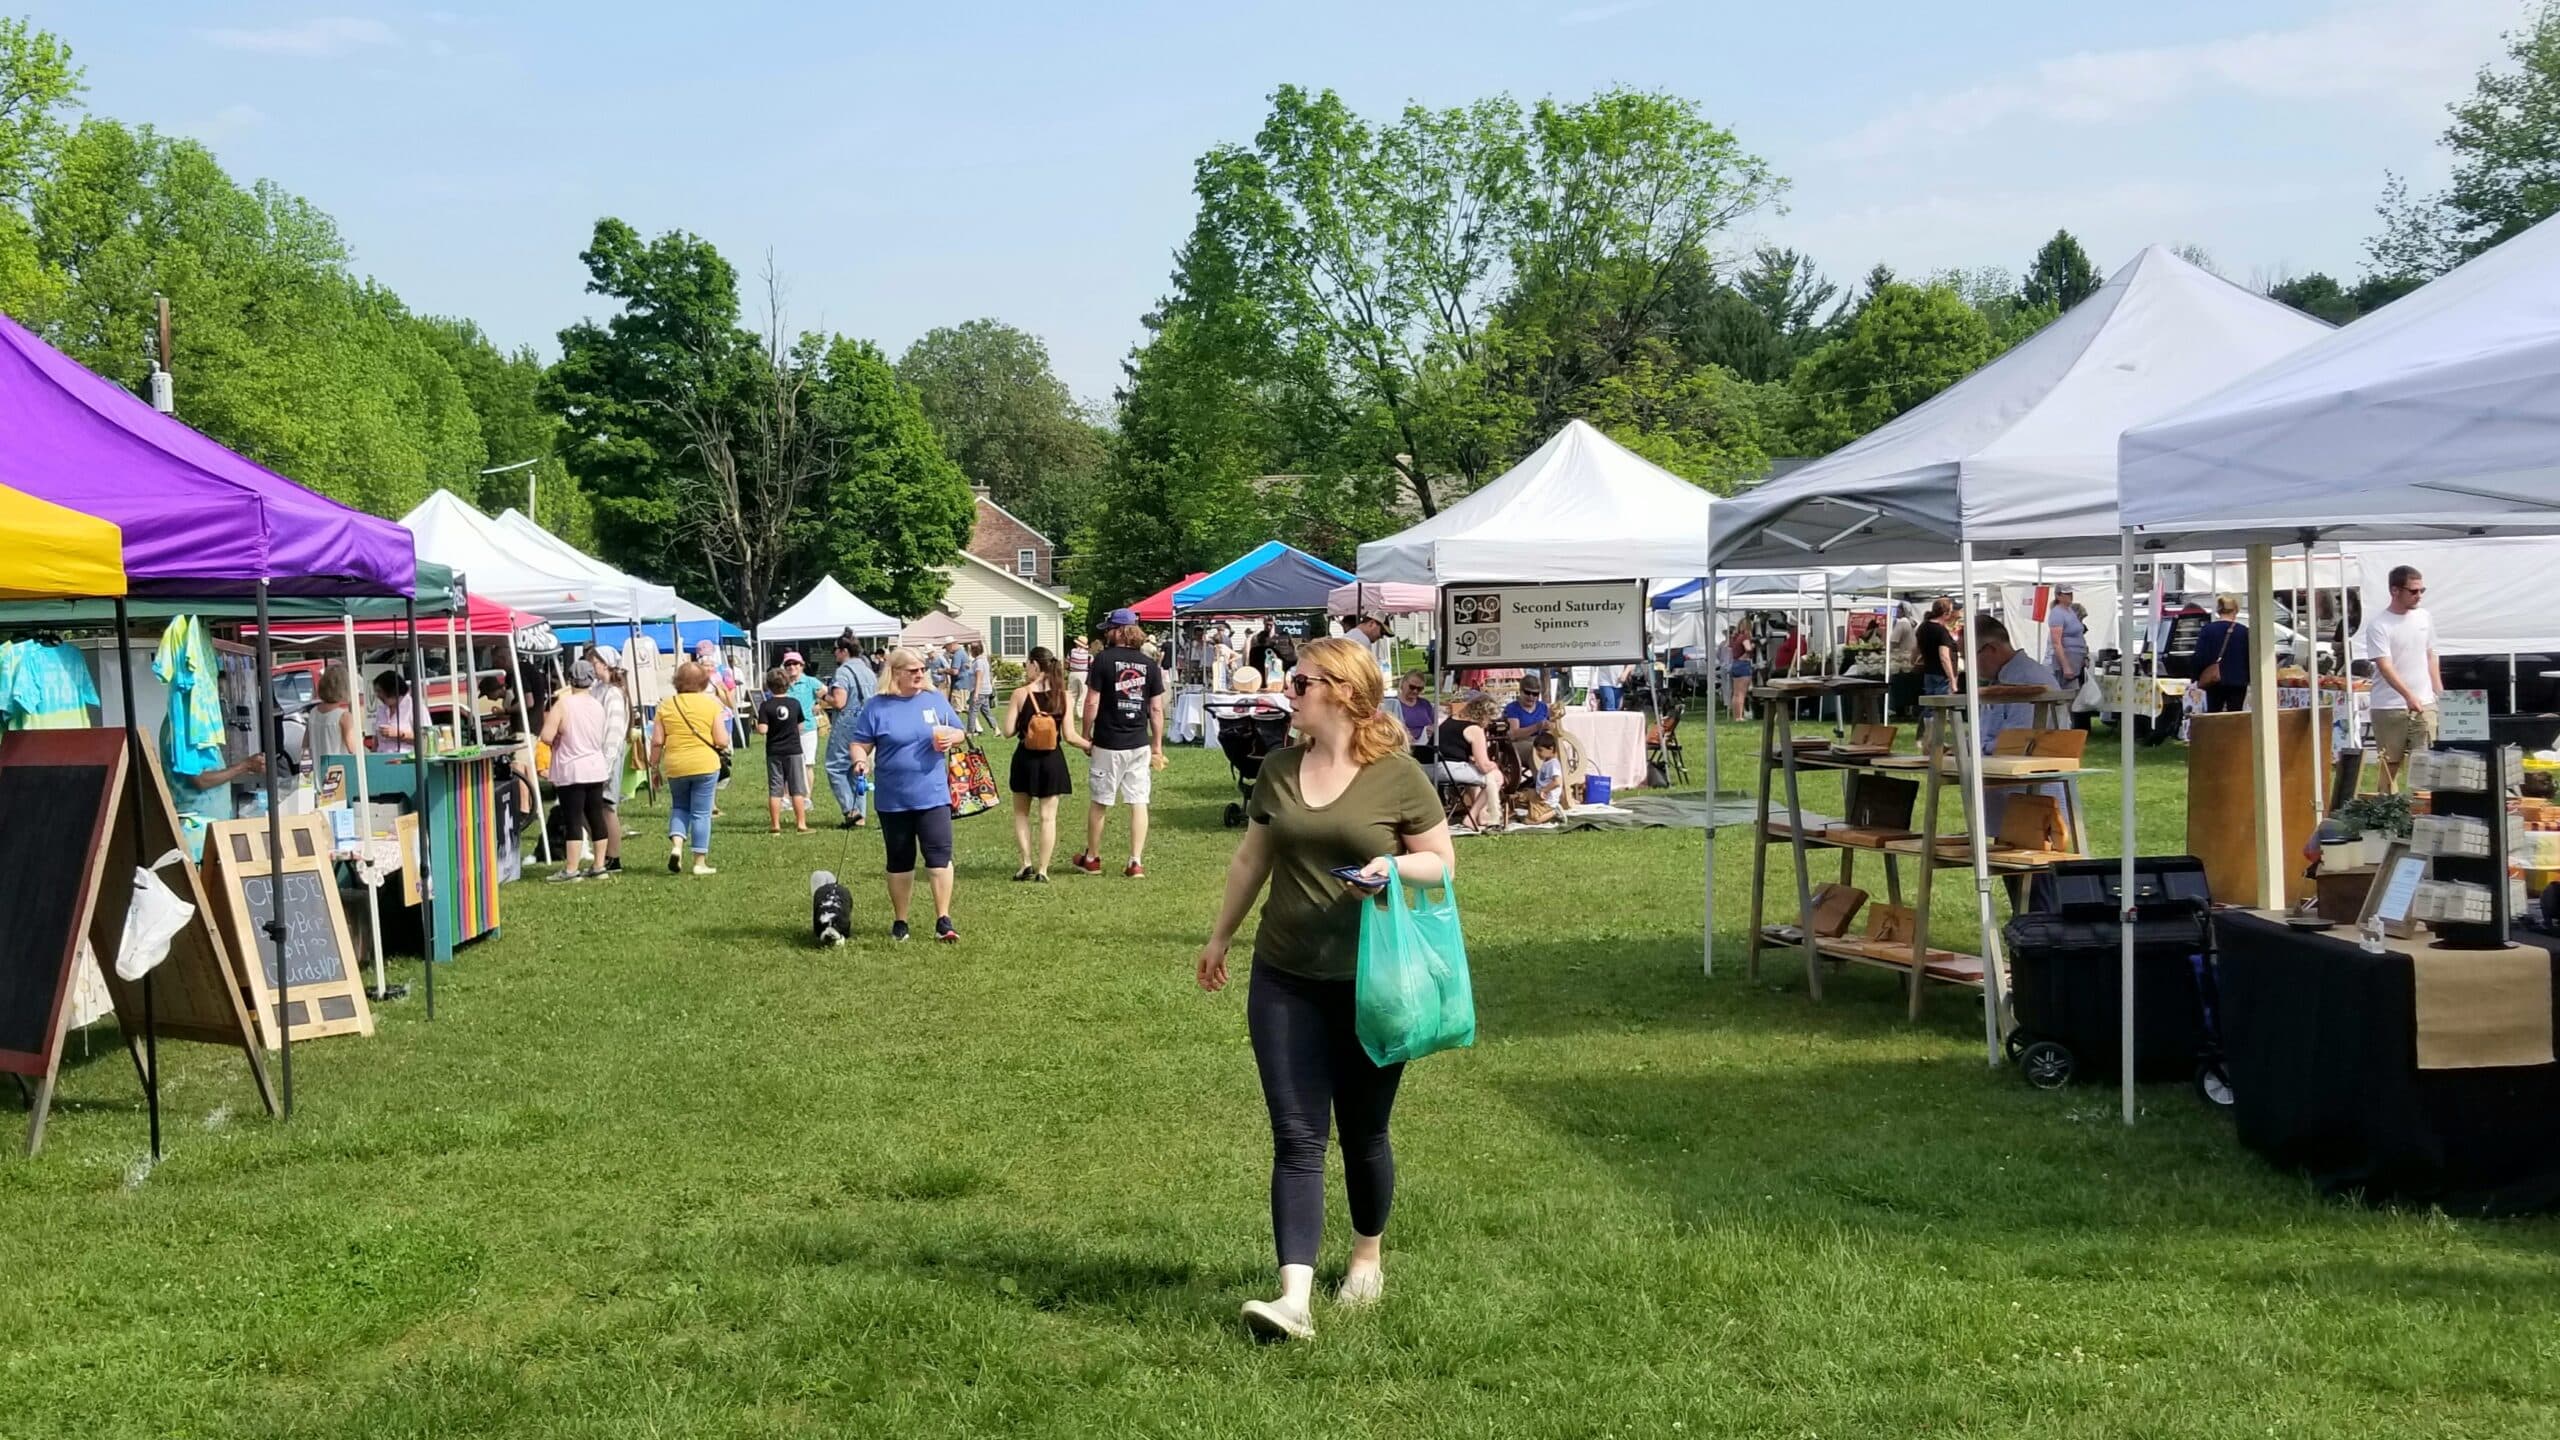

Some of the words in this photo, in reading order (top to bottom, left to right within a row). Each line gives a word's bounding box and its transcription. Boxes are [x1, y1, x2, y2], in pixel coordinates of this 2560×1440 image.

[1512, 600, 1561, 614] Second
[1565, 600, 1625, 614] Saturday
[1534, 618, 1589, 632] Spinners
